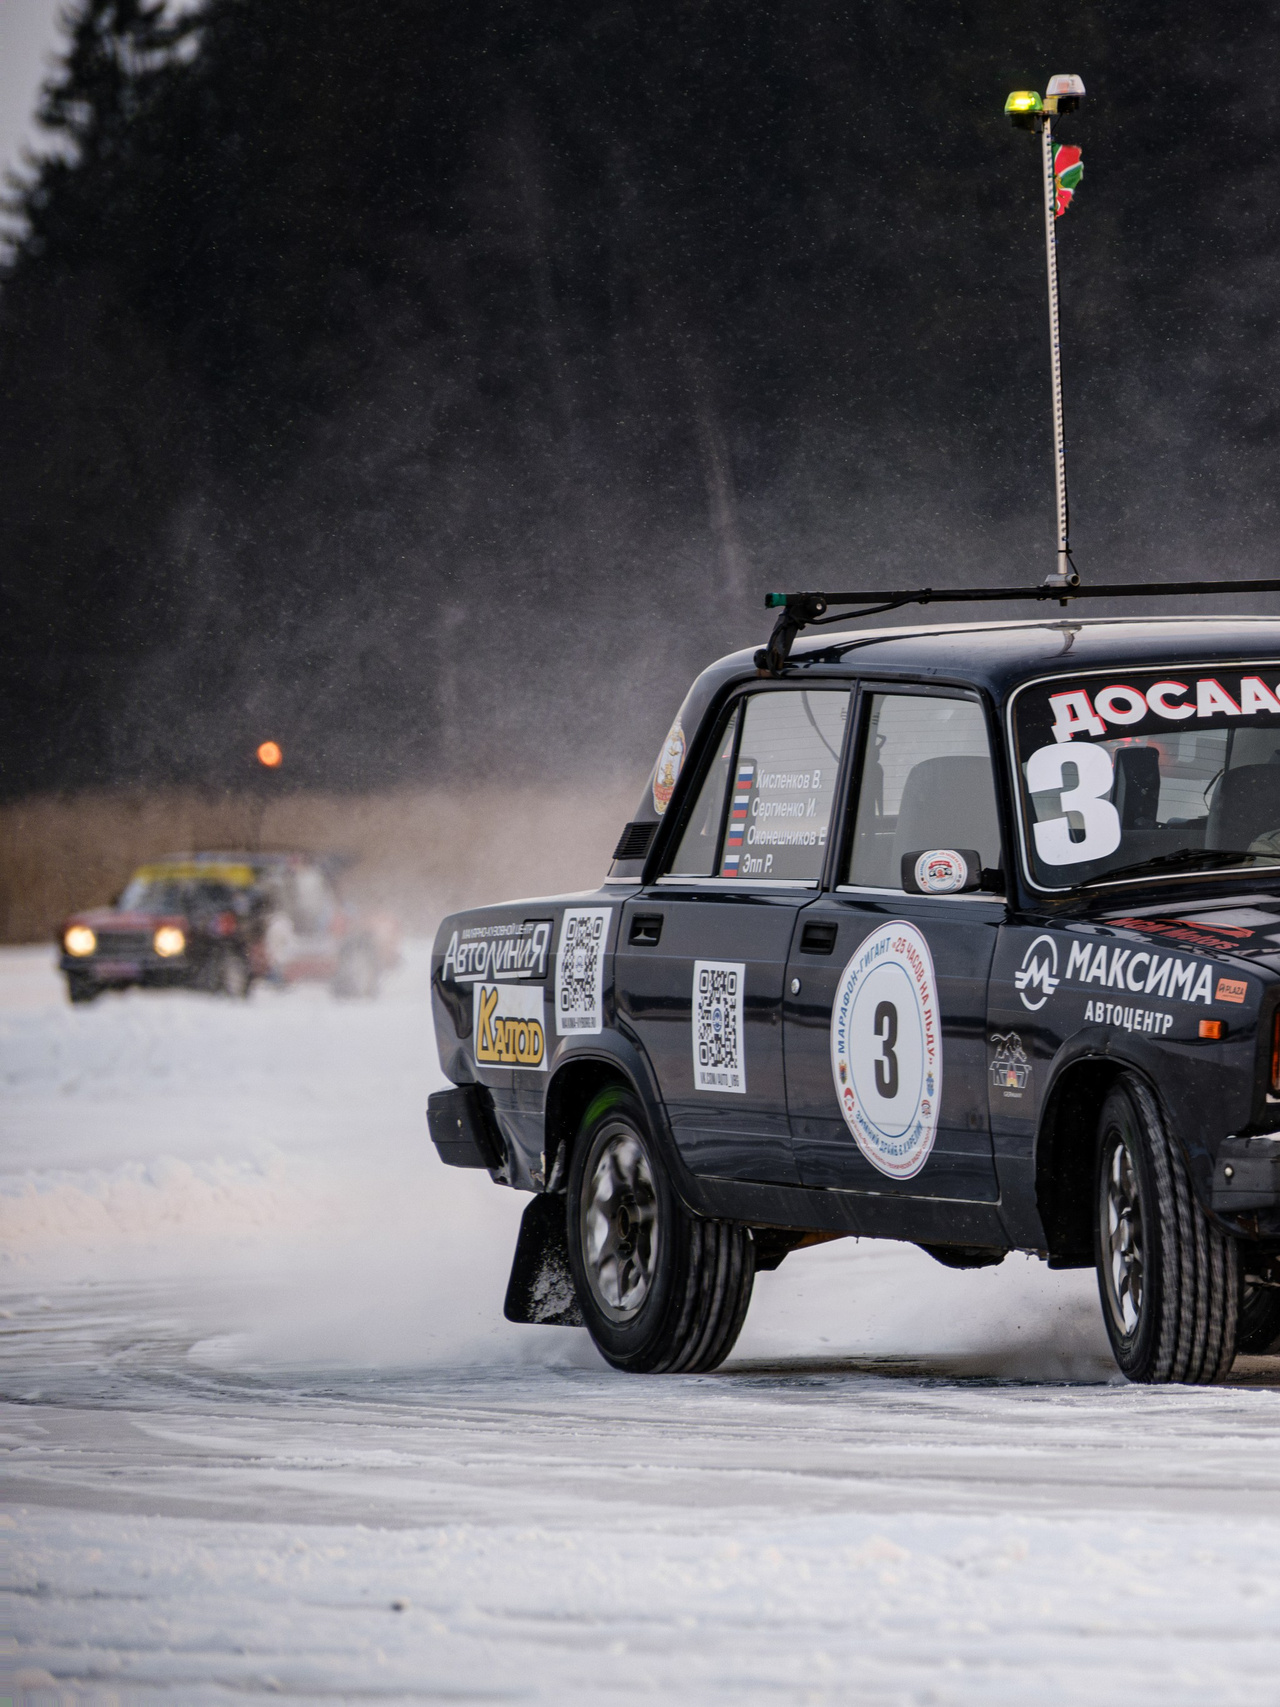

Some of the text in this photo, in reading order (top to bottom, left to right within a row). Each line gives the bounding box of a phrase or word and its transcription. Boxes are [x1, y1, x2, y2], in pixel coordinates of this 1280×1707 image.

[755, 769, 822, 789] Кисленков В.
[751, 797, 817, 821] Сергиенко И.
[1026, 741, 1122, 866] 3
[747, 825, 816, 846] Оконешников
[742, 853, 773, 873] Эпп Р.
[1158, 928, 1240, 950] Motors
[1065, 940, 1213, 1005] МАКСИМА
[837, 937, 892, 1054] МАРАФОН-ГИГАНТ
[906, 942, 925, 983] ЧАСОВ
[919, 981, 930, 1006] НА
[1084, 1000, 1174, 1035] АВТОЦЕНТР
[873, 1000, 899, 1100] 3
